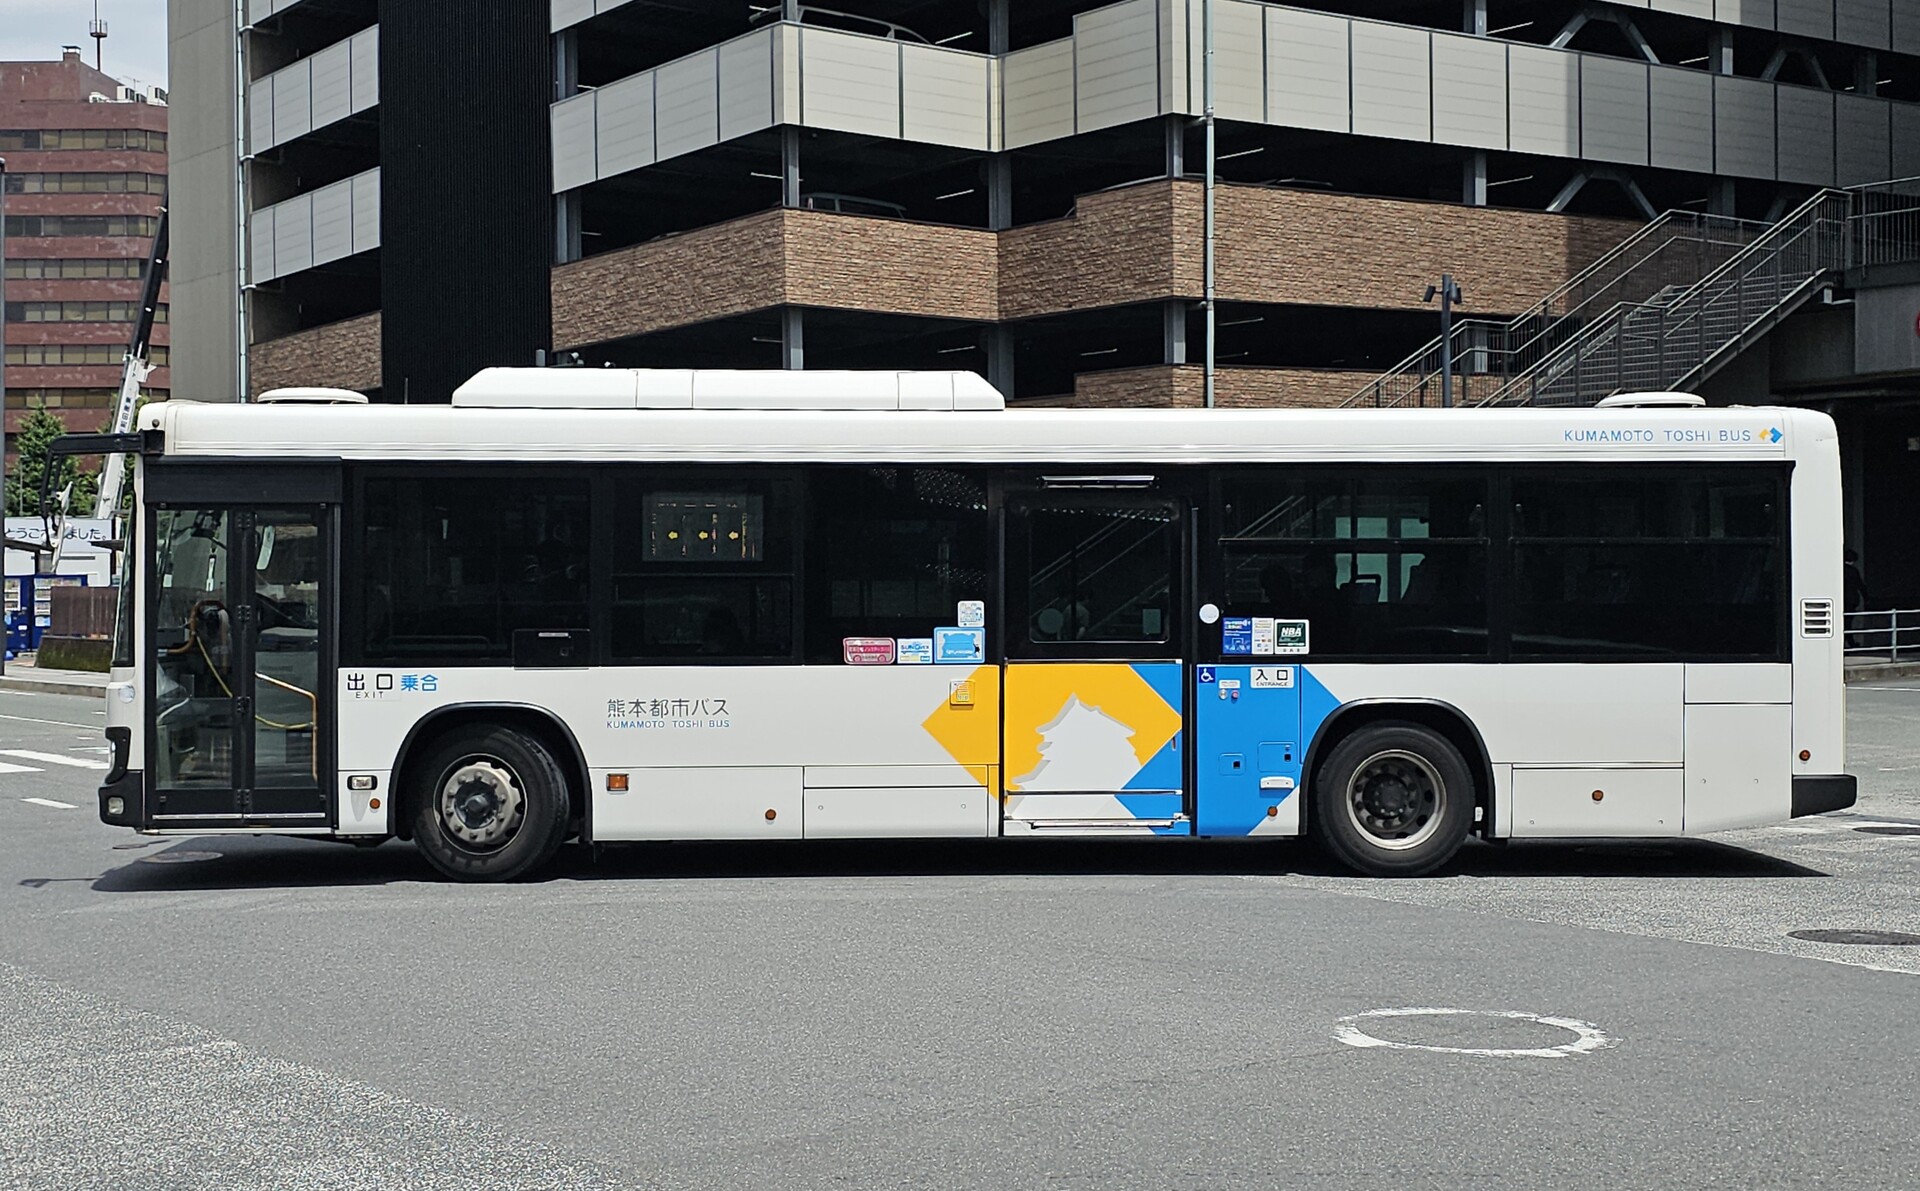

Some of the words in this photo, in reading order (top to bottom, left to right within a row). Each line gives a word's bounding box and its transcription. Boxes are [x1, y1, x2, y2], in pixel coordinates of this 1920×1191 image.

[1564, 430, 1654, 441] KUMAMOTO
[1664, 430, 1711, 441] TOSHI
[1719, 430, 1751, 441] BUS
[1256, 669, 1288, 681] 入口
[347, 673, 393, 691] 出口
[401, 674, 438, 691] 乗合
[355, 691, 384, 699] EXIT
[607, 698, 730, 718] 熊本都市バス
[606, 720, 666, 729] KUMAMOTO
[672, 720, 703, 728] TOSHI
[708, 720, 730, 728] BUS
